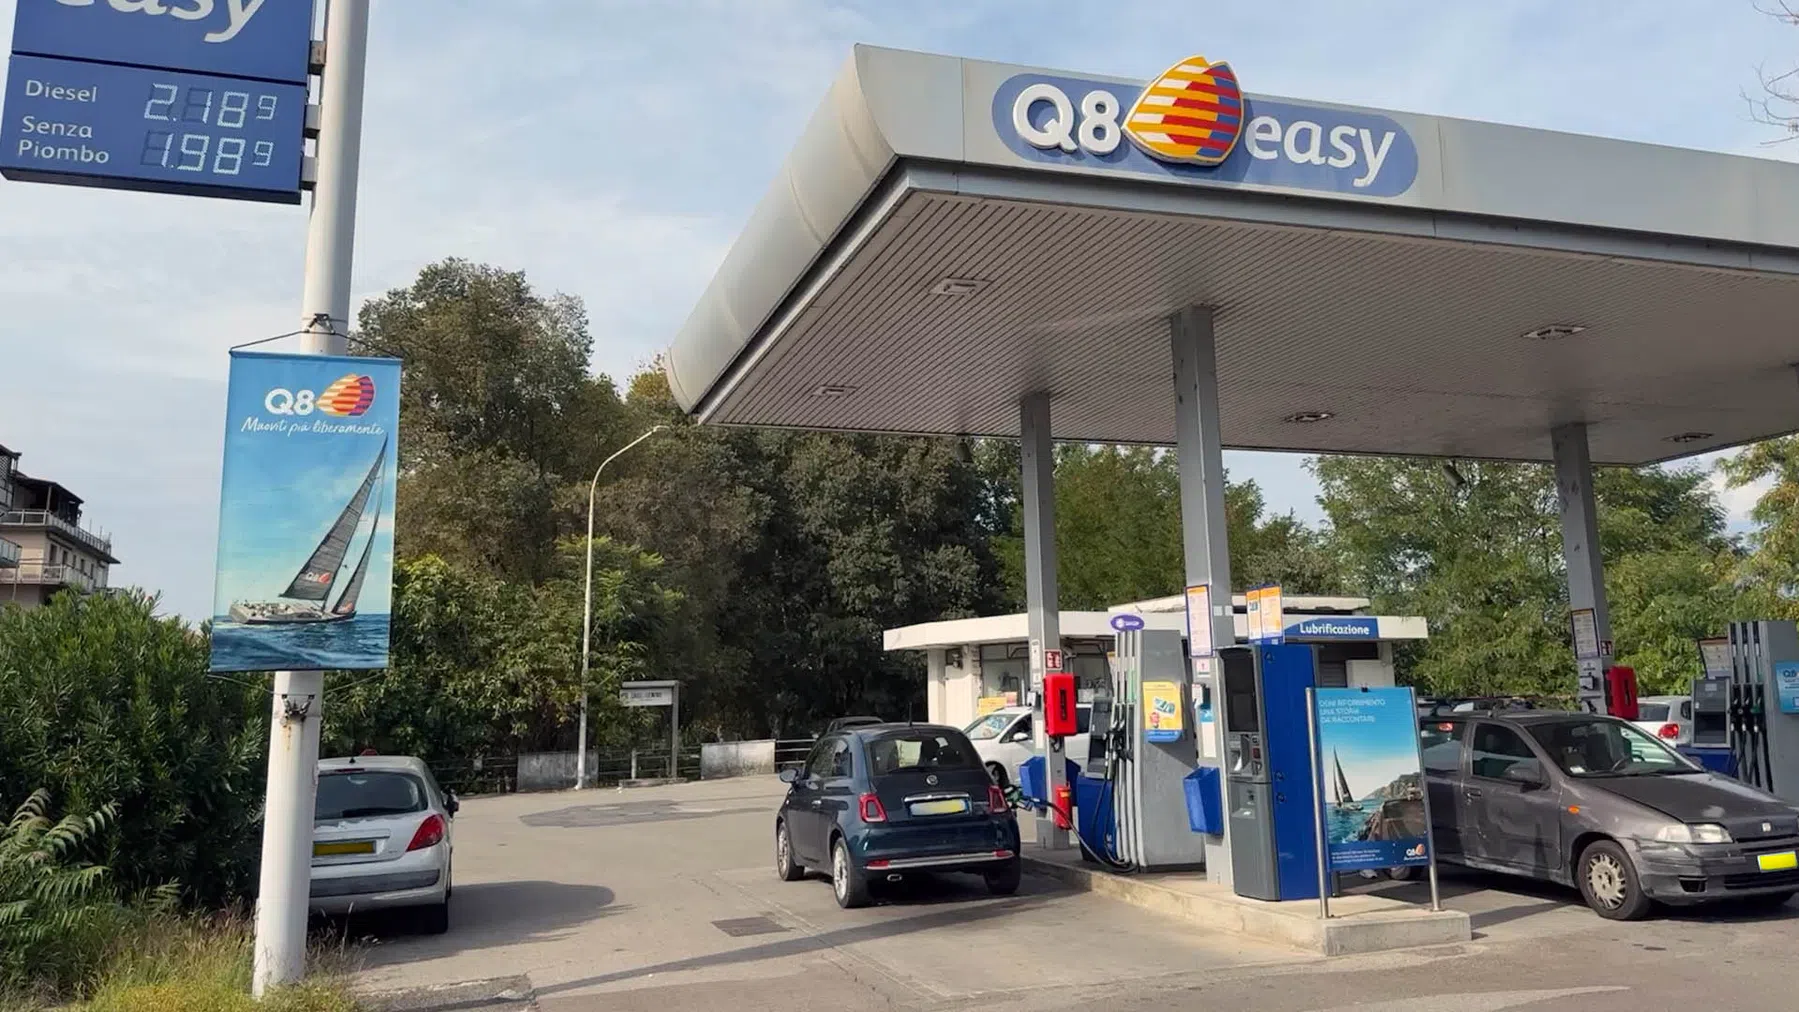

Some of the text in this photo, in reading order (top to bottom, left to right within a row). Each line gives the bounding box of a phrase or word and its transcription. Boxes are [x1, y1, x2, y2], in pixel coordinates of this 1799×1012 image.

[25, 80, 97, 103] Diesel
[22, 116, 93, 139] Senza
[1012, 83, 1396, 187] Q8 easy
[18, 139, 110, 164] Piombo
[265, 388, 316, 416] Q8
[312, 420, 384, 435] liberamente
[1300, 624, 1370, 635] Lubrificazione
